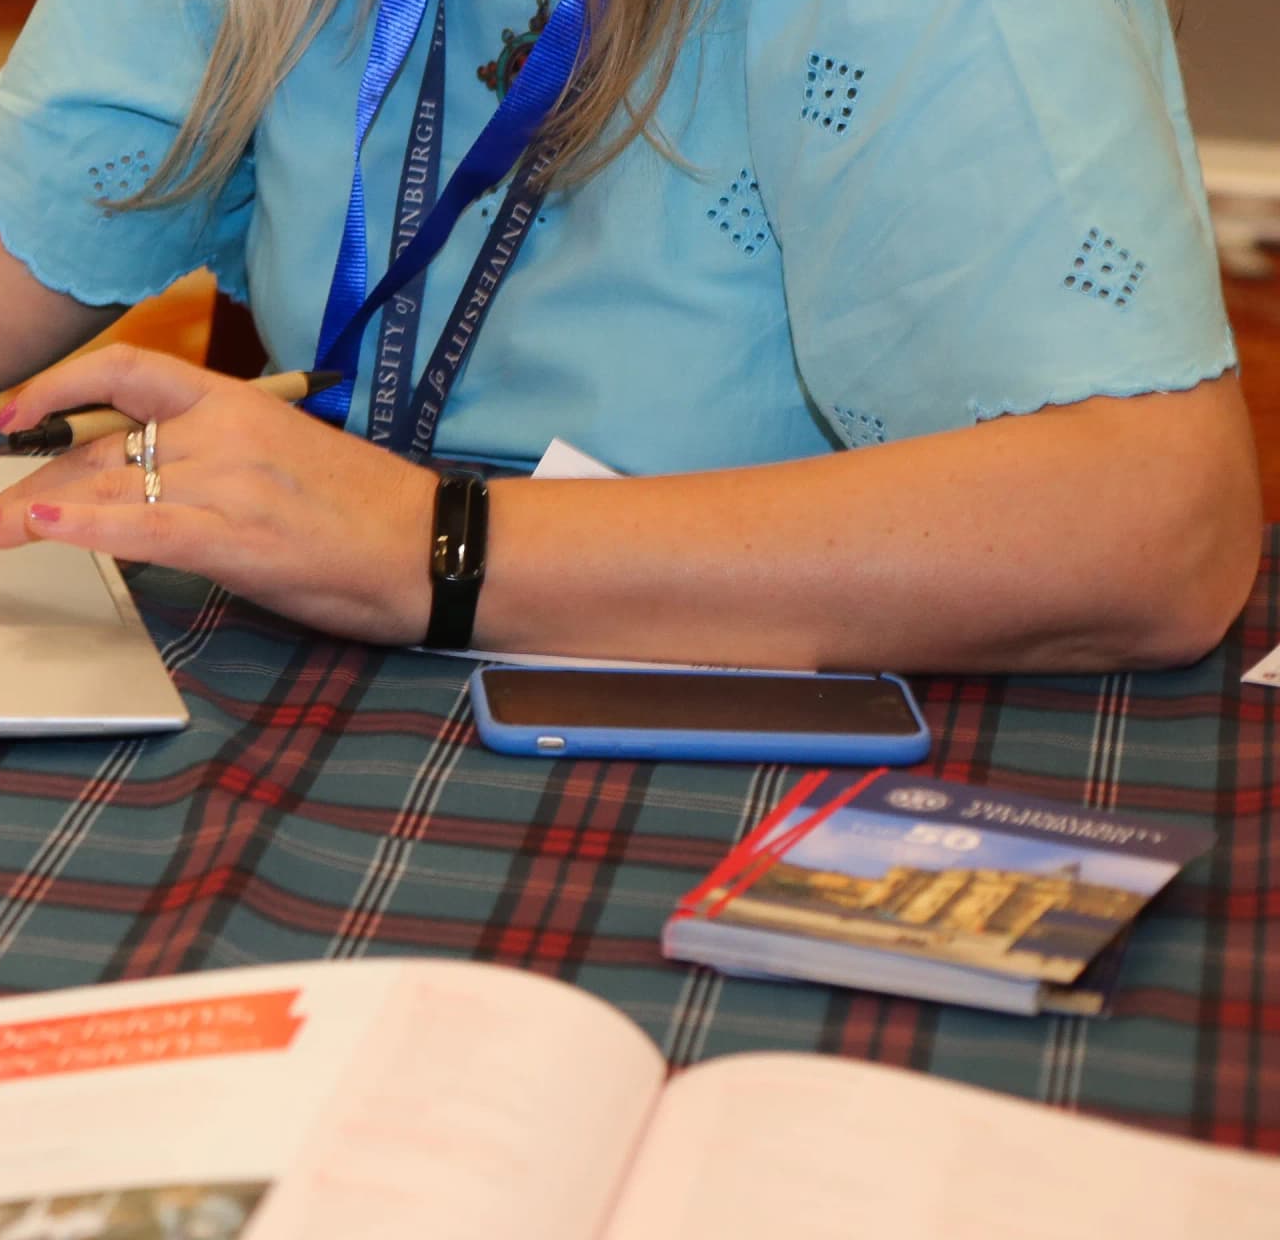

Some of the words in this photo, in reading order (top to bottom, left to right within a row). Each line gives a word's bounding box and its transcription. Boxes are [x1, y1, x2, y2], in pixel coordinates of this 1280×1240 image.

[396, 100, 437, 259] INBURGH
[393, 293, 417, 315] of
[444, 202, 532, 370] UNIVERSITY
[372, 319, 405, 441] VERSITY
[428, 368, 446, 401] of
[902, 822, 981, 852] 50
